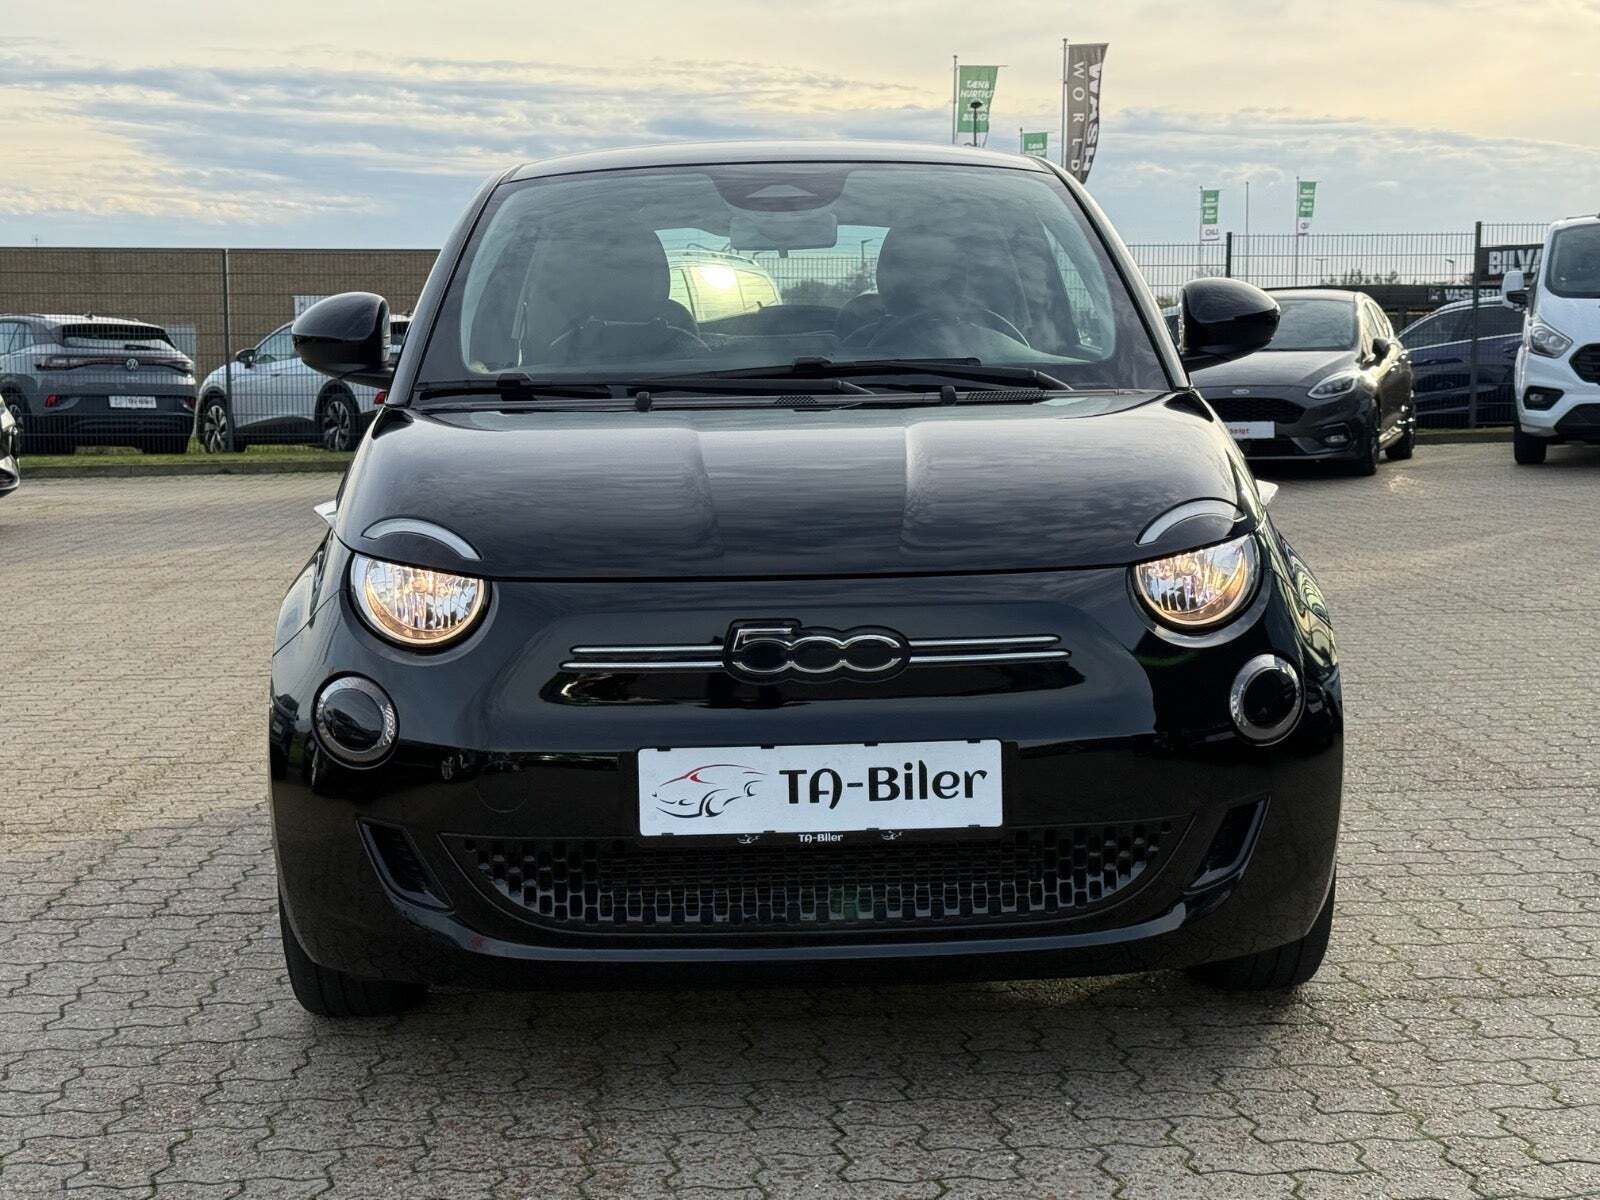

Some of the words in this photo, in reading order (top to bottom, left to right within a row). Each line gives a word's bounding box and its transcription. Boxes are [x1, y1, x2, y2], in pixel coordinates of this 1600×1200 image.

[1071, 61, 1086, 171] WORLD
[1082, 62, 1102, 171] WASH
[732, 627, 902, 673] 500
[778, 760, 988, 810] TA-Biler
[798, 833, 844, 844] TA-Biler
